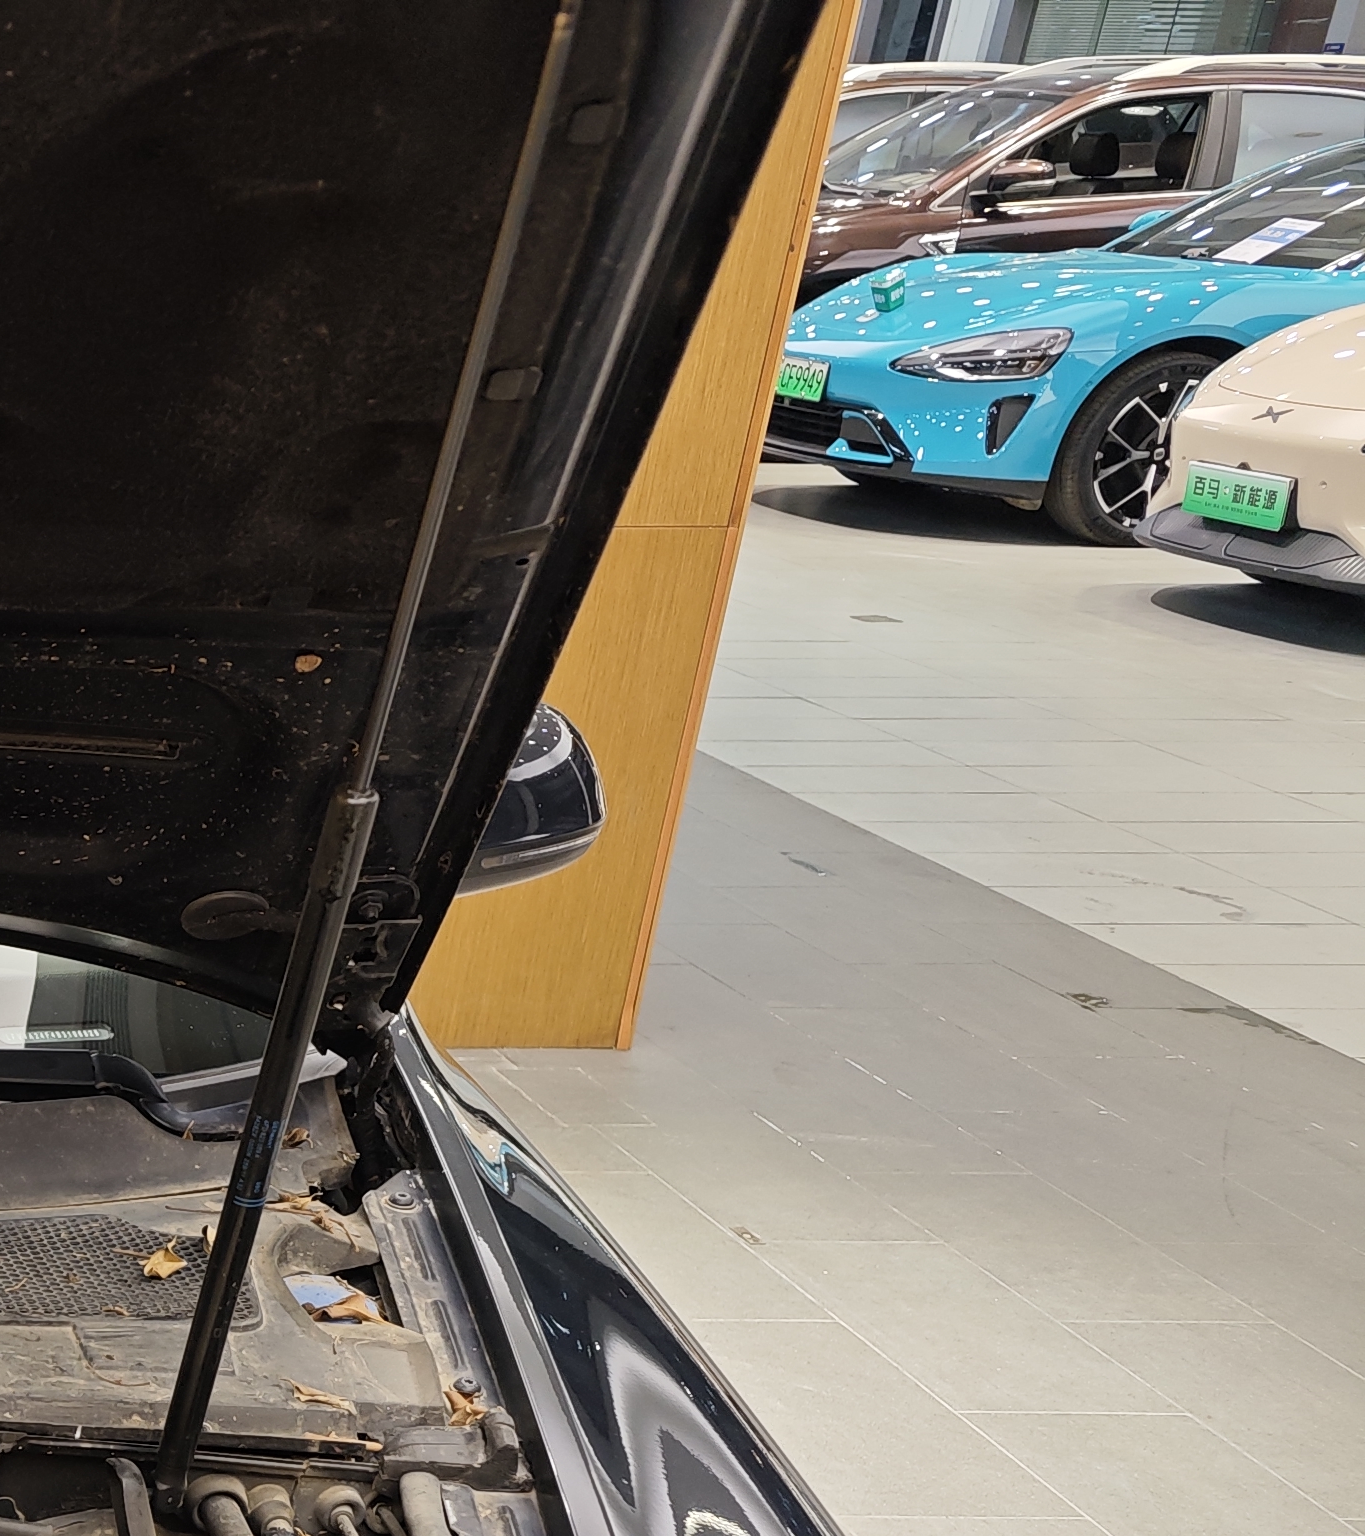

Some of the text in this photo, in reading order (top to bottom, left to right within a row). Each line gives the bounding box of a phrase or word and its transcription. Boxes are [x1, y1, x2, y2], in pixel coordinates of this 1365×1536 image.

[781, 363, 823, 393] CF9949
[1231, 484, 1278, 510] 新能源
